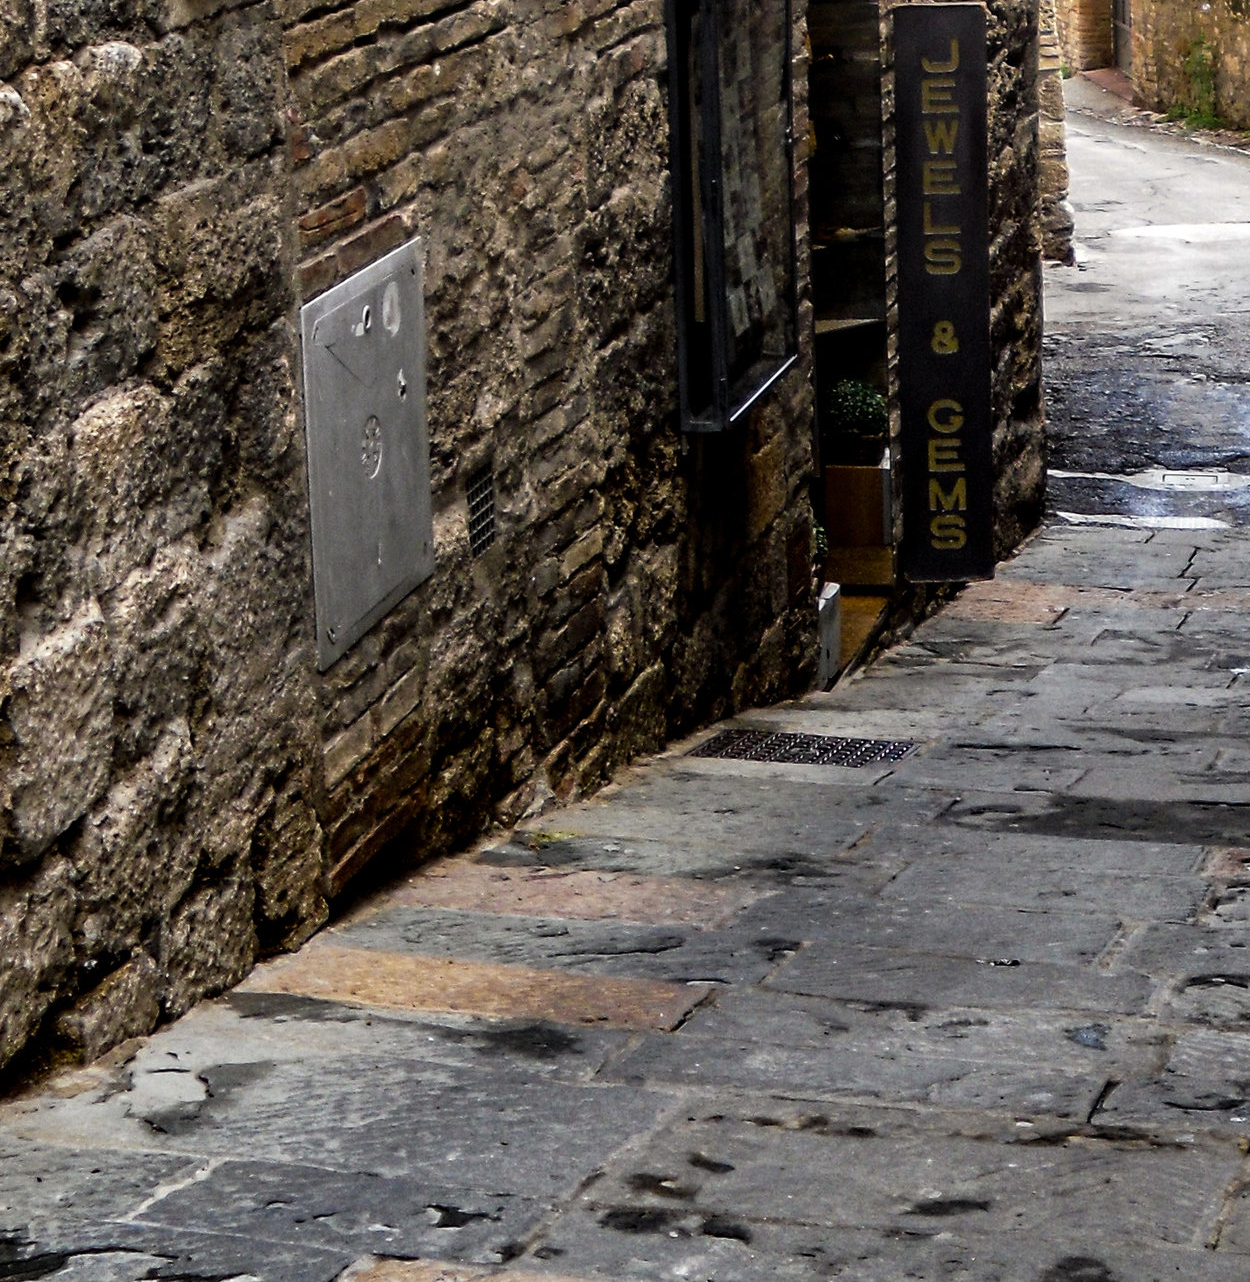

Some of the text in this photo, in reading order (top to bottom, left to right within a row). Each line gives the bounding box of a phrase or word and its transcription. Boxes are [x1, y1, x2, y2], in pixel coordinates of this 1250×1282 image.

[921, 37, 967, 550] JEWELS & GEMS
